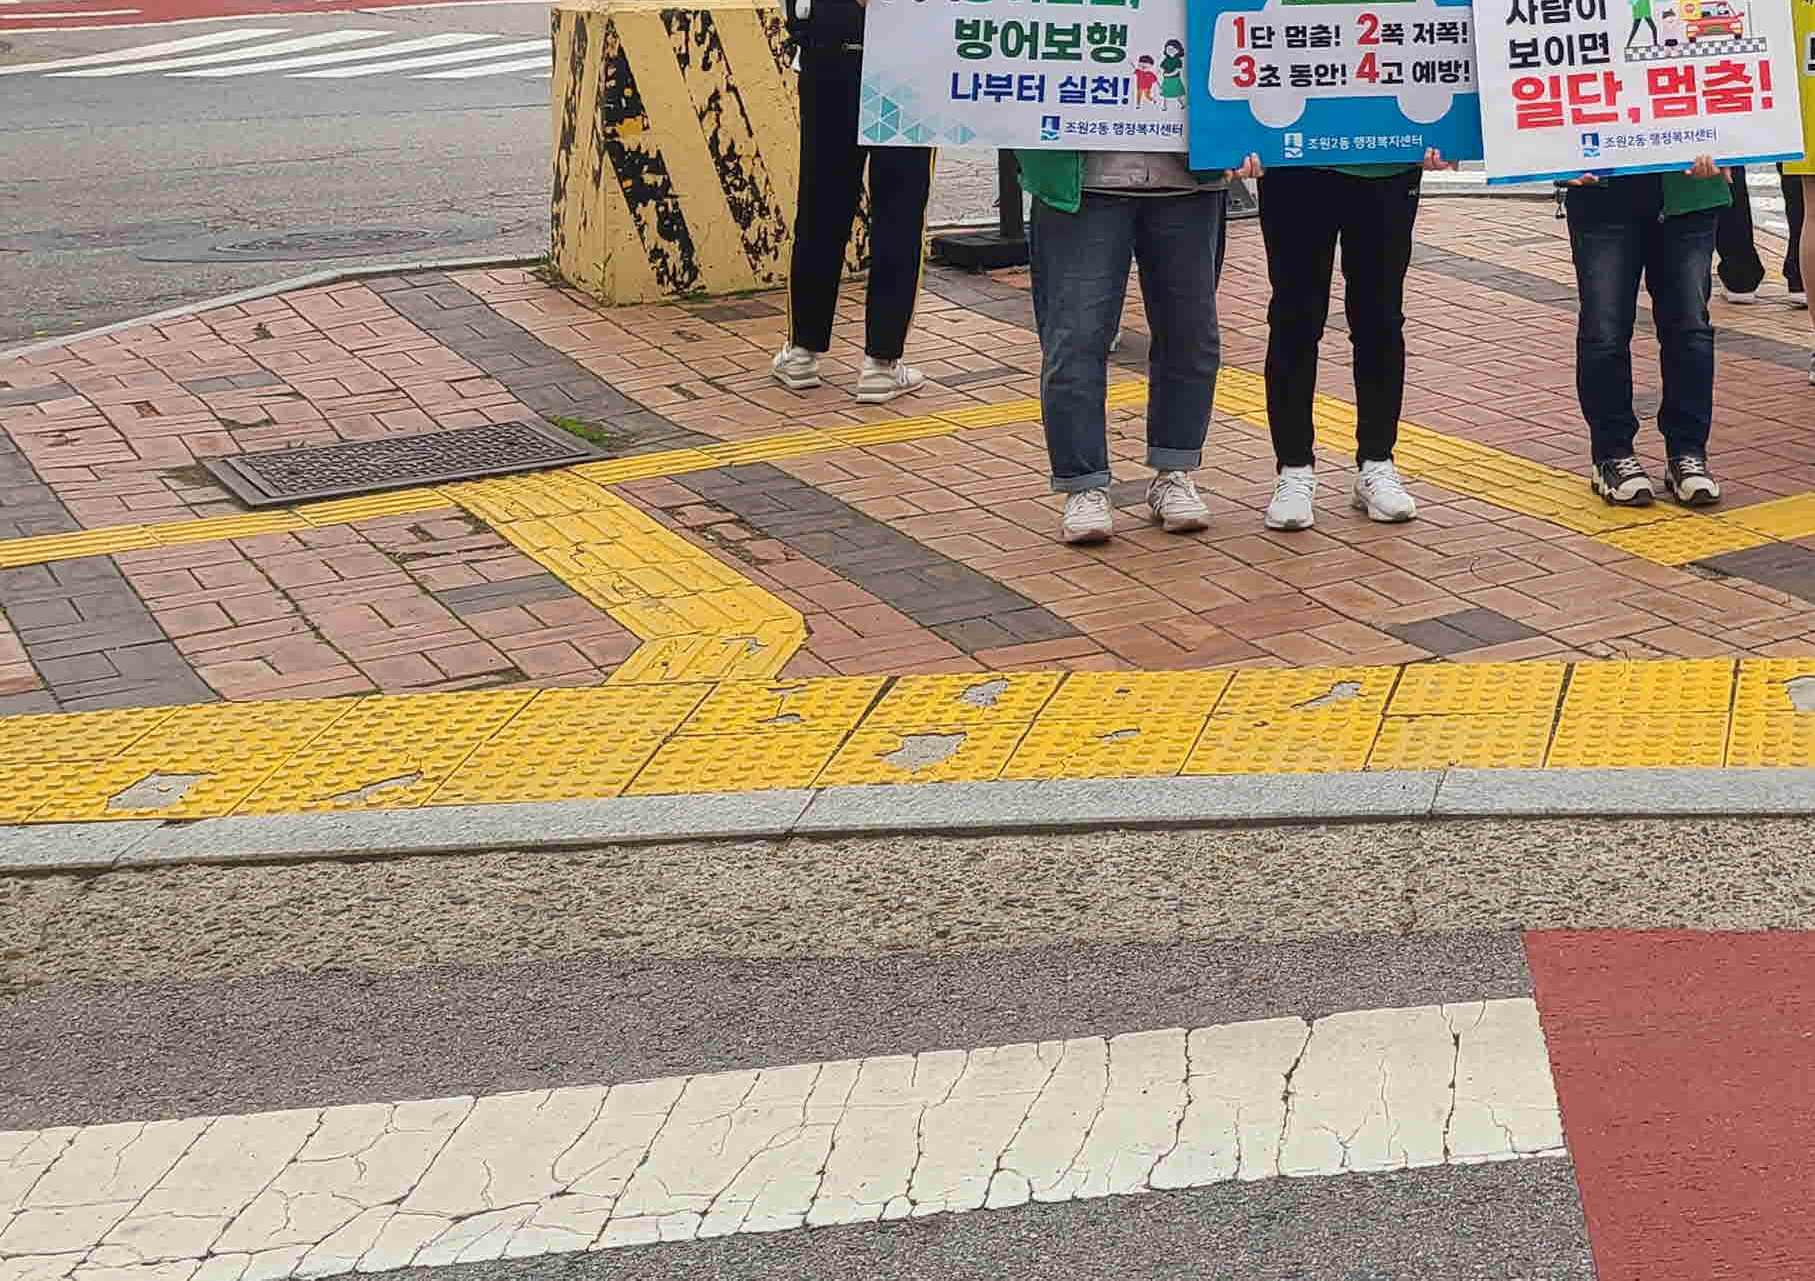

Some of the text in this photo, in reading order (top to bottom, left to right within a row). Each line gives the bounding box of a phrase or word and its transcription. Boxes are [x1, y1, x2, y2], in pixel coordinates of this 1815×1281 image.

[955, 19, 1128, 64] 방어보행
[1232, 12, 1468, 49] 1단 멈춤! 2쪽 저쪽!
[1508, 32, 1610, 70] 보이면
[1232, 52, 1470, 88] 3초 동안! 4고 예방!
[952, 72, 1130, 105] 나부터 실천!
[1511, 59, 1774, 130] 일단, 멈춤!
[1065, 121, 1184, 137] 조원2동 행정복지센터
[1308, 134, 1424, 151] 조원2동 행정복지센터
[1604, 129, 1718, 149] 조원2동 행정복지센터
